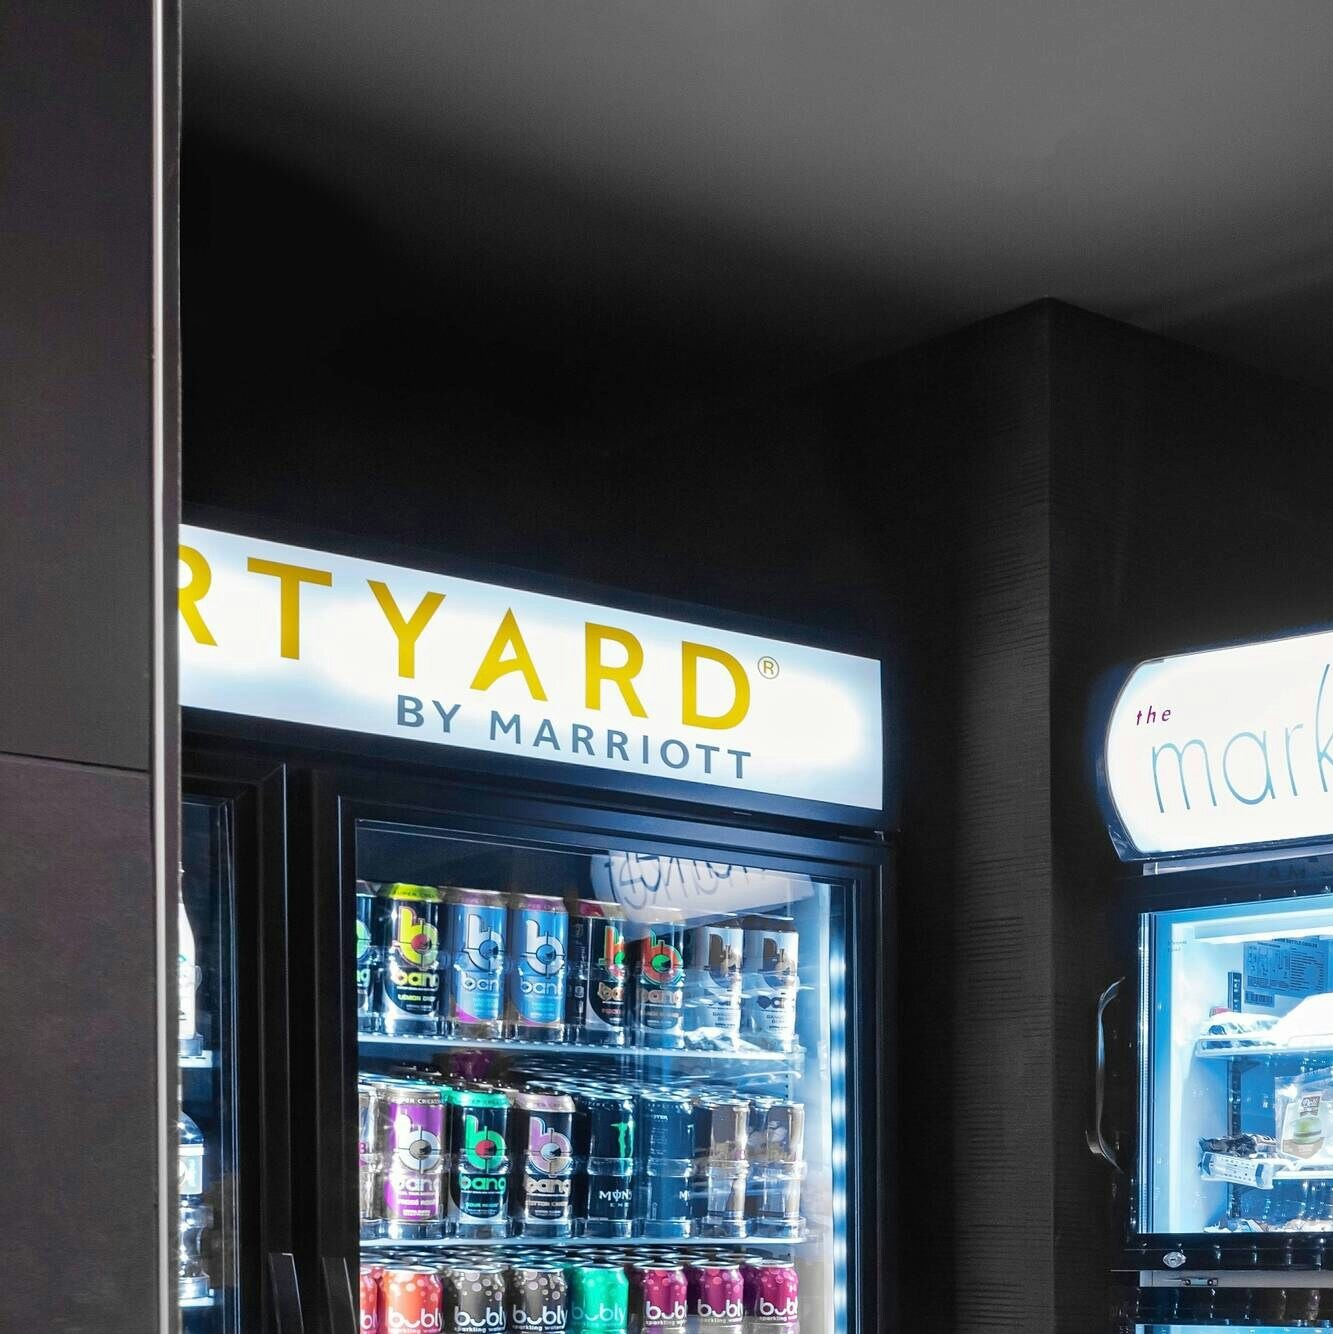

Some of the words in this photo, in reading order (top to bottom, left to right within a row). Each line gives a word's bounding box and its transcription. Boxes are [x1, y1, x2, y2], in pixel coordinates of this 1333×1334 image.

[1136, 704, 1172, 726] the
[397, 694, 462, 733] BY
[490, 710, 752, 780] MARRIOTT
[512, 1303, 569, 1330] bubly
